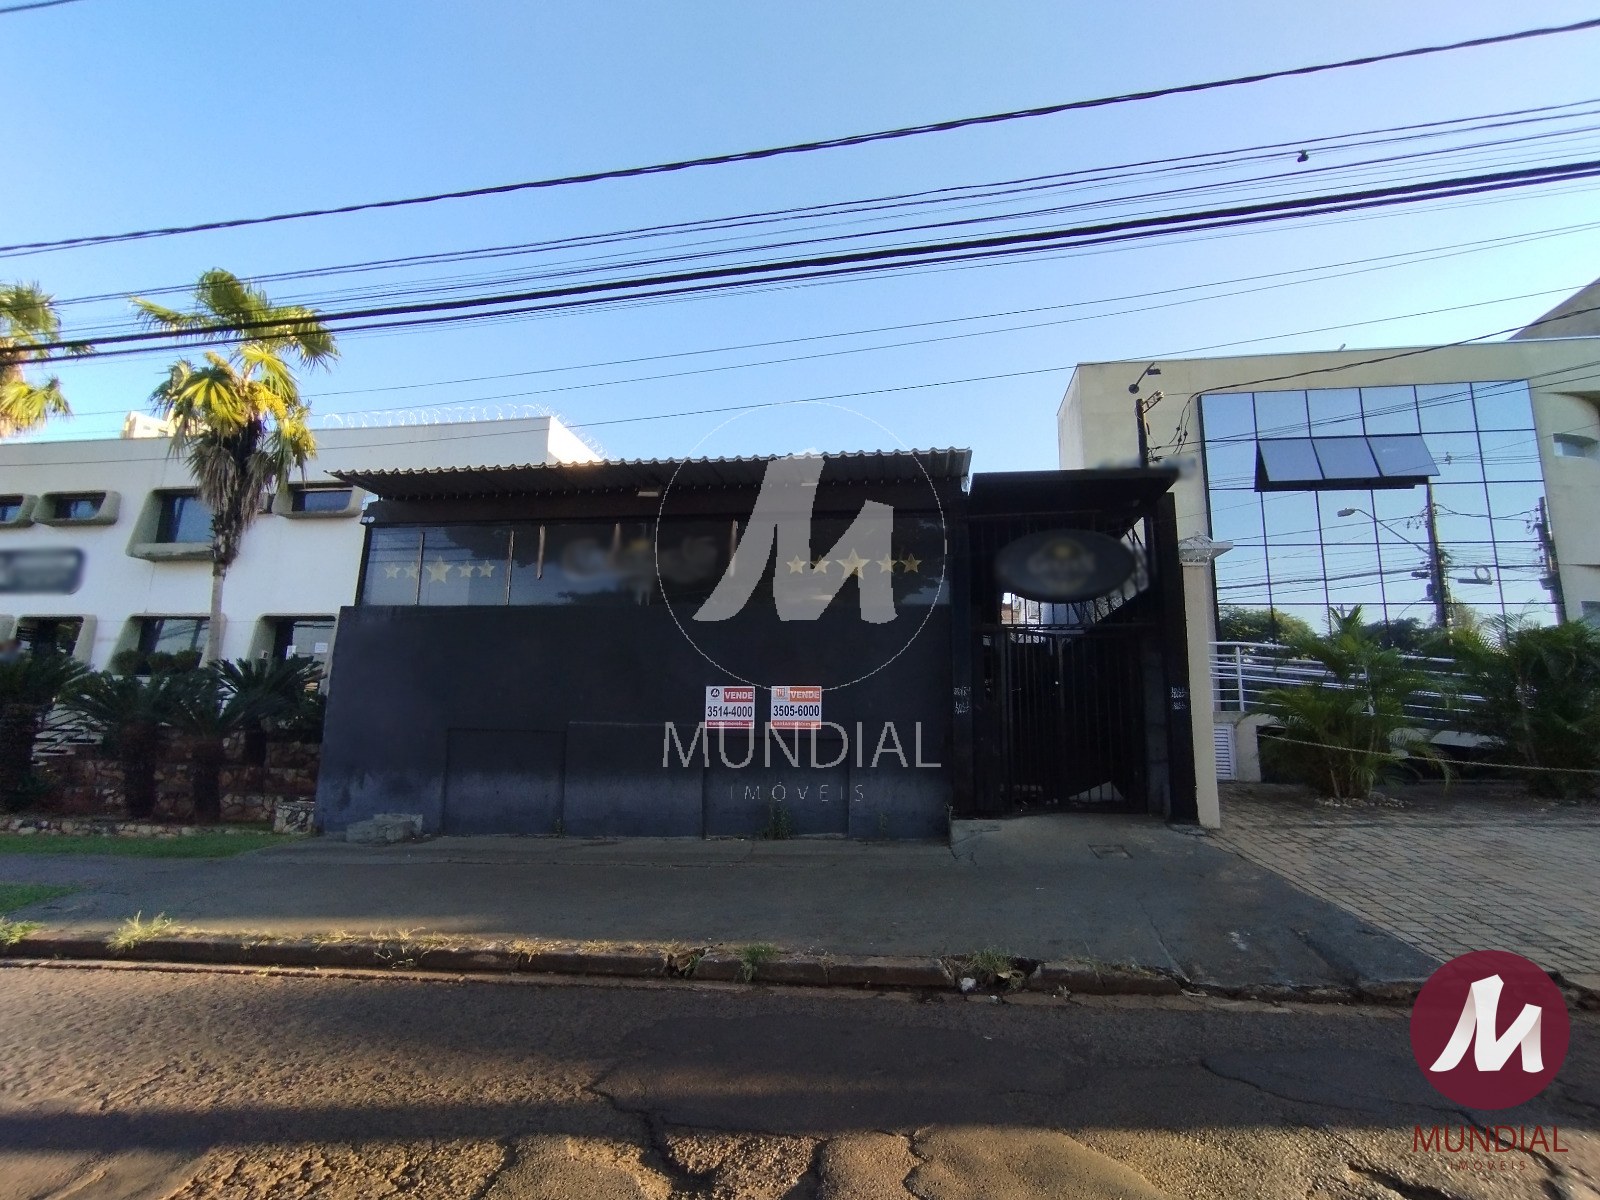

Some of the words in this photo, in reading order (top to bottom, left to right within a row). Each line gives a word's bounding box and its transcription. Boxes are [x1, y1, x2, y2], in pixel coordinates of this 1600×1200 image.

[724, 691, 754, 700] VENDE
[790, 690, 820, 699] VENDE
[707, 705, 753, 717] 3514-4000
[773, 705, 820, 717] 3505-6000
